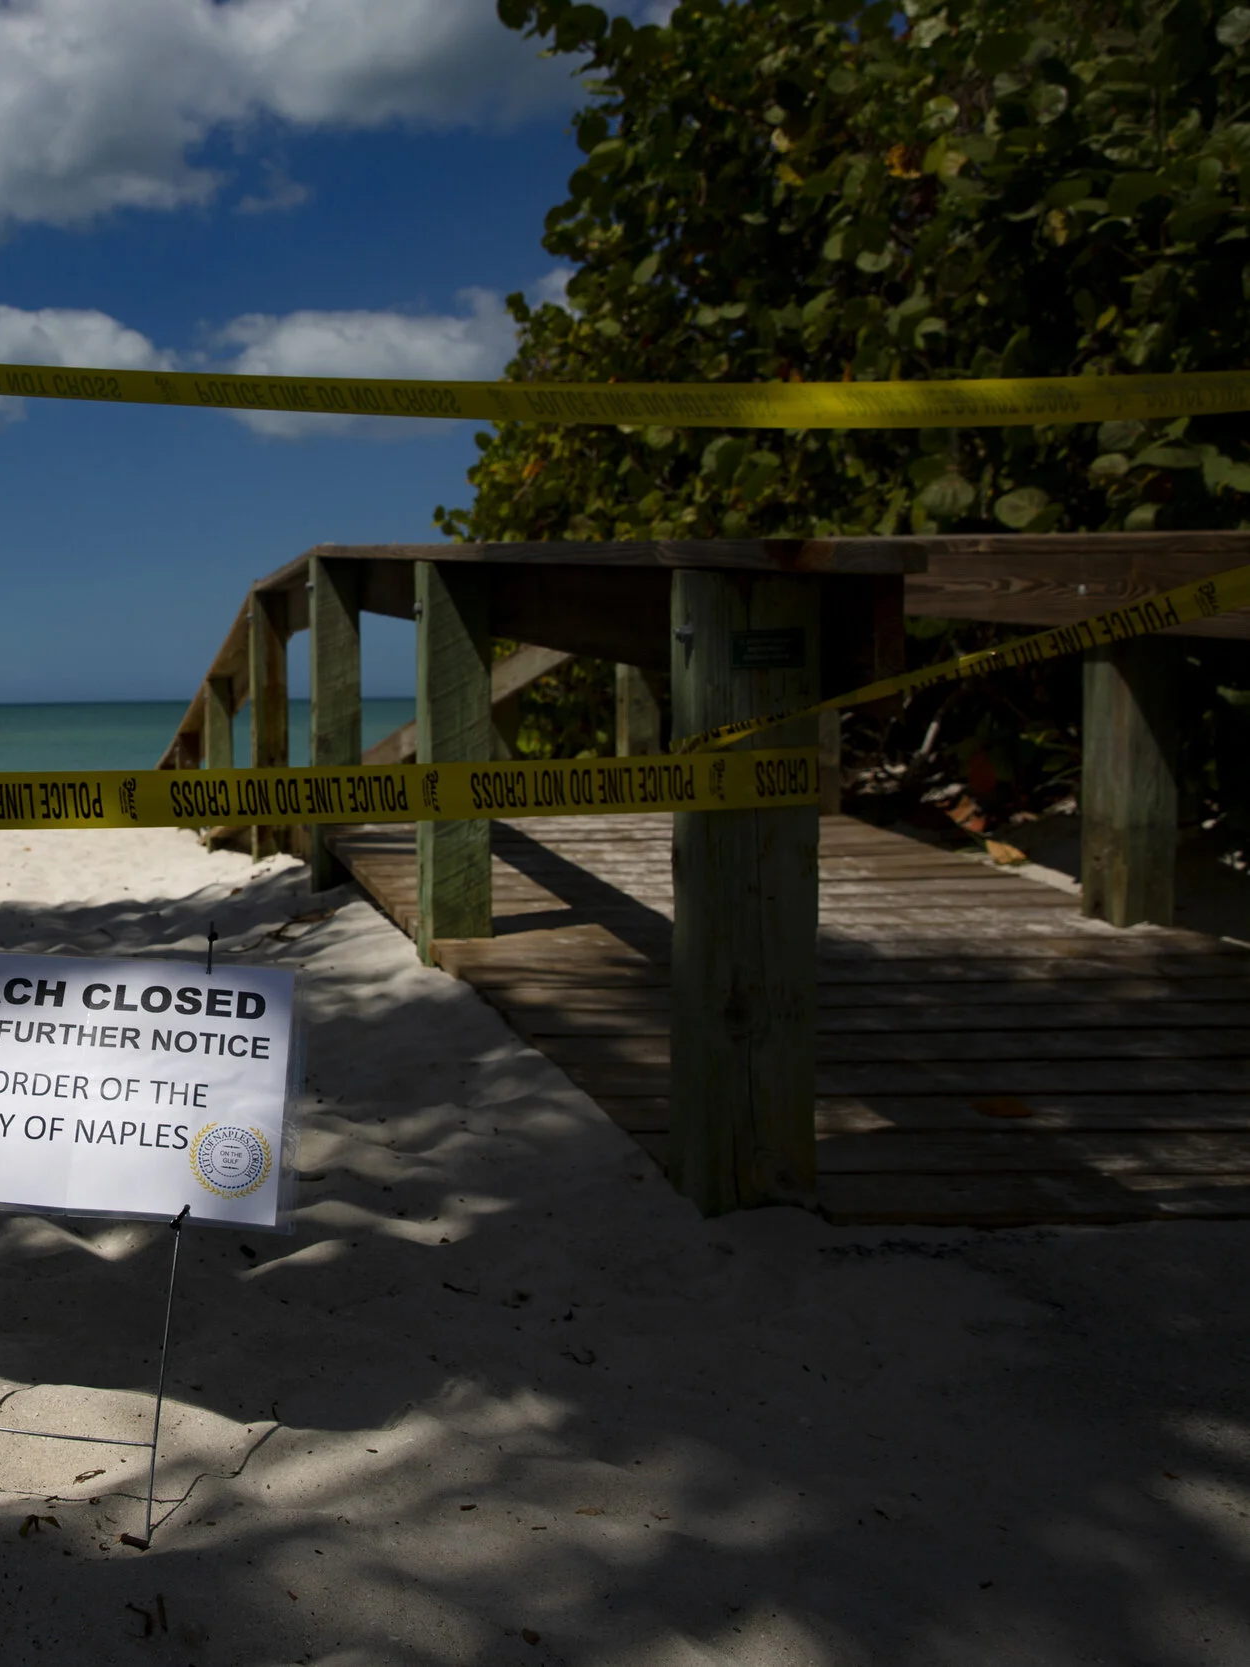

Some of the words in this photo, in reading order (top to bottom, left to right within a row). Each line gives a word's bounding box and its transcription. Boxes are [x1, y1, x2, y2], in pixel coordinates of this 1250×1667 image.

[304, 777, 344, 813] LINE
[347, 775, 408, 813] POLICE
[471, 771, 527, 809] CROSS
[534, 770, 566, 807] NOT
[570, 769, 594, 805] DO
[597, 767, 634, 804] LINE
[638, 764, 695, 802] POLICE
[756, 758, 808, 797] CROSS
[39, 782, 103, 819] POLICE
[170, 780, 230, 818] CROSS
[237, 779, 272, 816] NOT
[275, 779, 302, 815] DO
[82, 983, 267, 1019] CLOSED
[152, 1029, 270, 1059] NOTICE
[101, 1077, 140, 1101] OF
[150, 1081, 208, 1108] THE
[25, 1116, 64, 1141] OF
[75, 1120, 188, 1150] NAPLES
